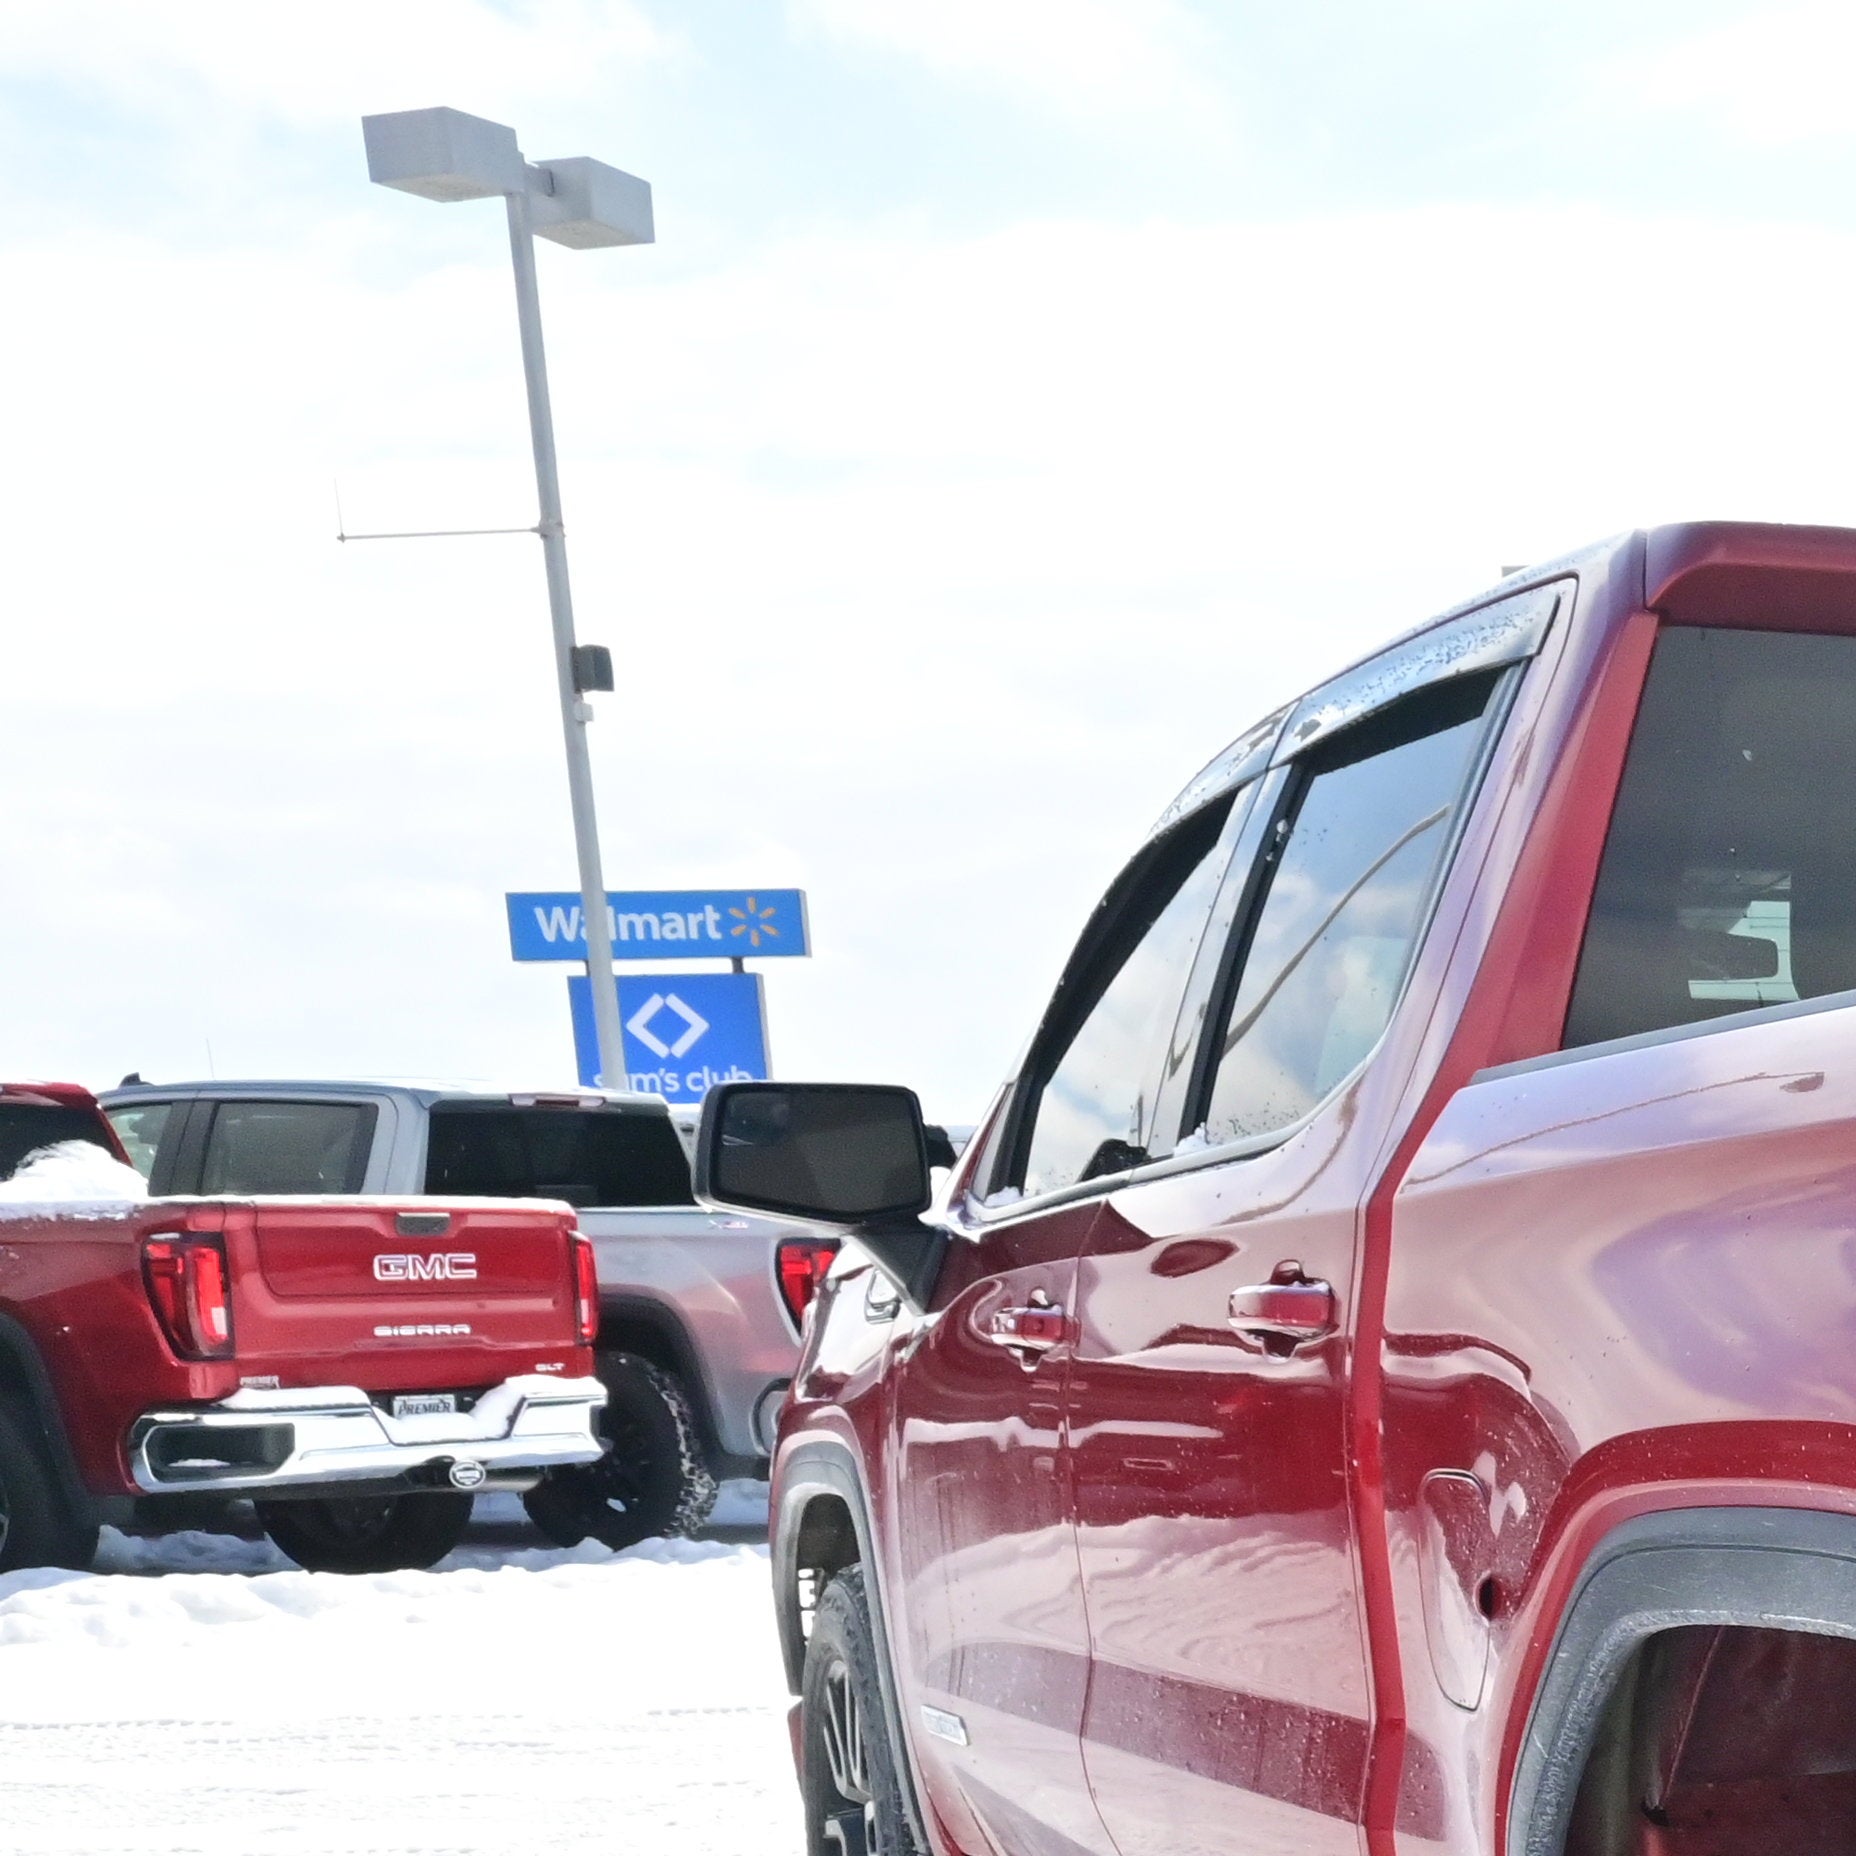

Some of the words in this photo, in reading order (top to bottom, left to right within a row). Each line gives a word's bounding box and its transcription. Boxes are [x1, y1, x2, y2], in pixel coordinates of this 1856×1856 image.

[533, 904, 723, 943] Wlmart
[373, 1253, 478, 1281] GMC
[398, 1399, 452, 1415] PREMIER
